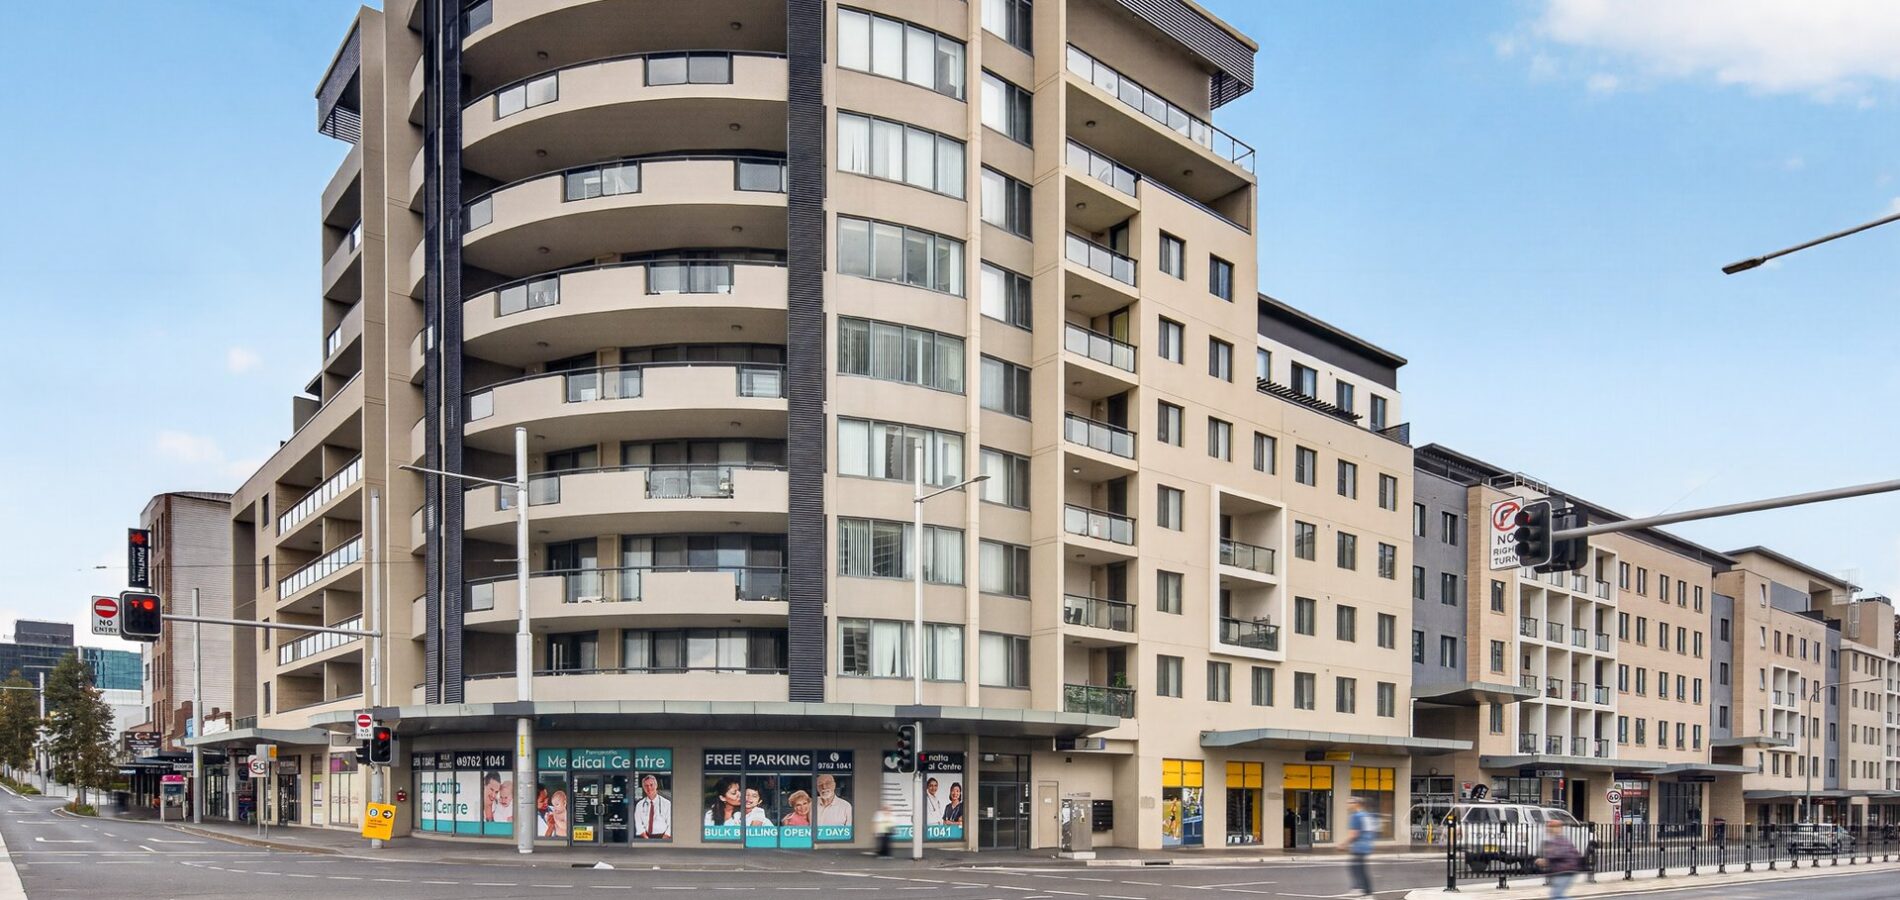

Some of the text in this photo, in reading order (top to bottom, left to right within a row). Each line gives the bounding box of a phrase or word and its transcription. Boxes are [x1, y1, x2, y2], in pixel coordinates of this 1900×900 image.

[1497, 532, 1515, 545] NO
[1493, 546, 1515, 556] RIGH
[1494, 555, 1519, 565] TURN
[99, 619, 113, 627] NO
[462, 755, 506, 767] 9762 1041
[547, 755, 666, 769] Medical Centre
[705, 754, 811, 766] FREE PARKING
[937, 762, 962, 770] Centre
[704, 828, 850, 837] BULK BILLING OPEN 7 DAYS
[928, 827, 951, 837] 1041
